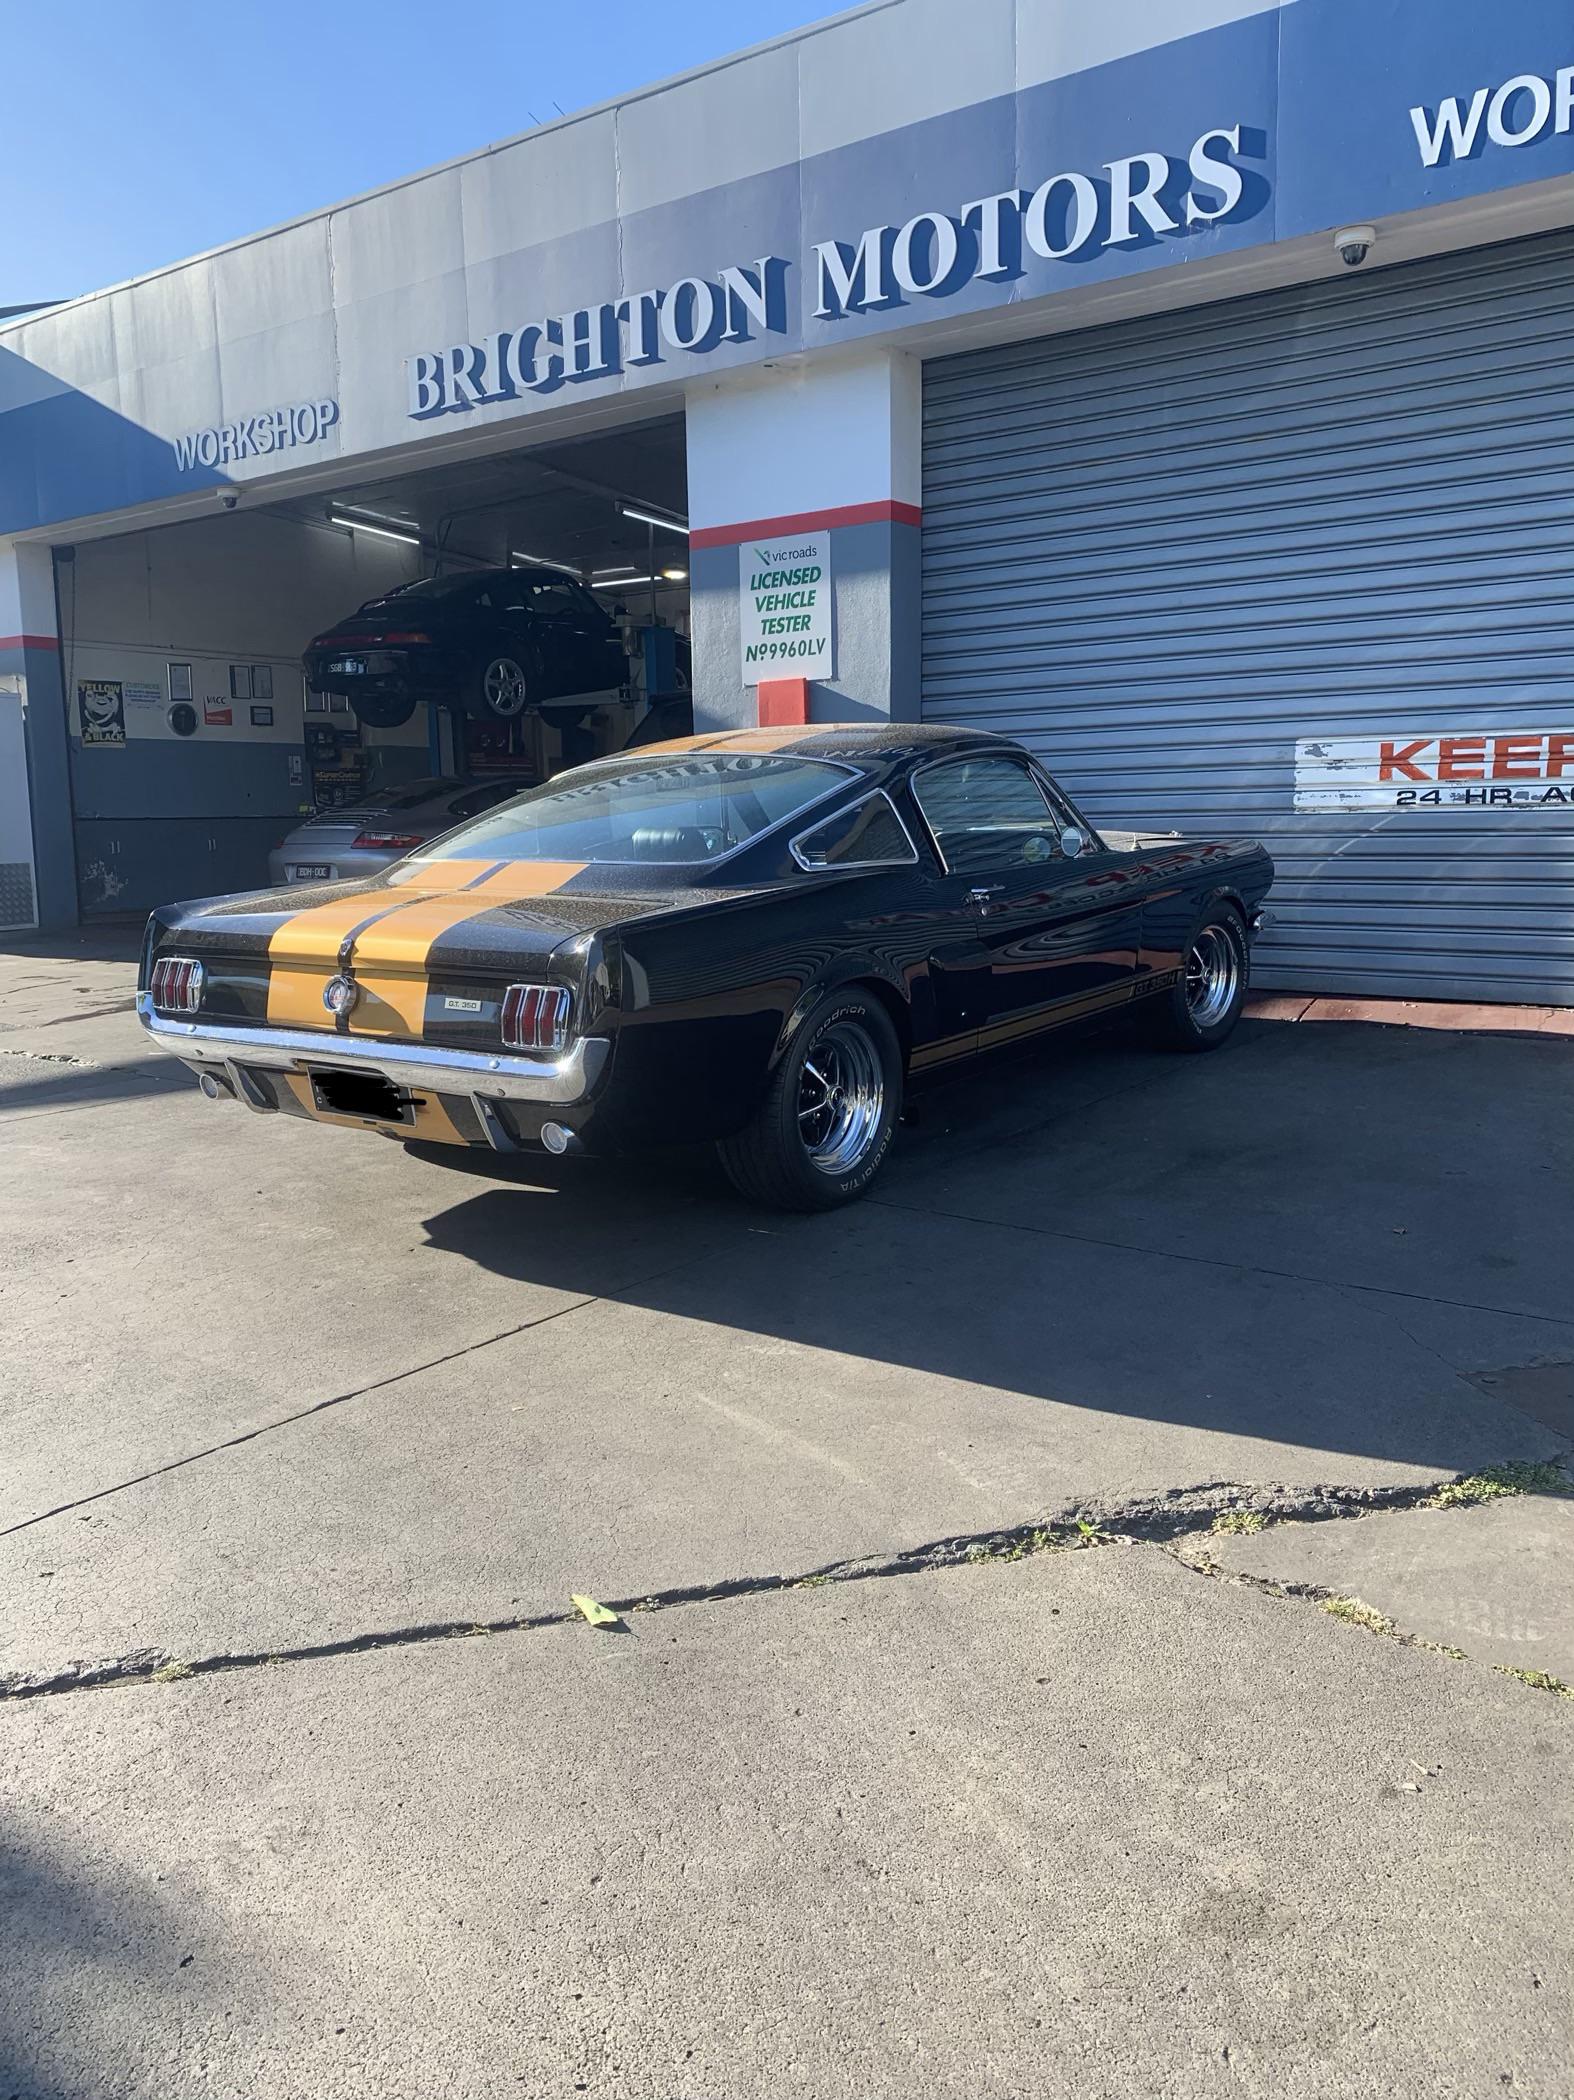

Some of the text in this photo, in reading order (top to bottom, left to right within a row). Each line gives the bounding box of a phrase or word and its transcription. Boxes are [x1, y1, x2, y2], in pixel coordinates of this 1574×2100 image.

[404, 123, 1245, 418] BRIGHTON MOTORS
[174, 399, 340, 472] WORKSHOP
[750, 565, 822, 591] LICENSED
[755, 590, 817, 612] VEHICLE
[760, 614, 812, 635] TESTER
[80, 683, 121, 694] YELLOW
[206, 695, 226, 705] VACC
[93, 732, 124, 742] BLACK
[1396, 786, 1574, 806] 24 HR A
